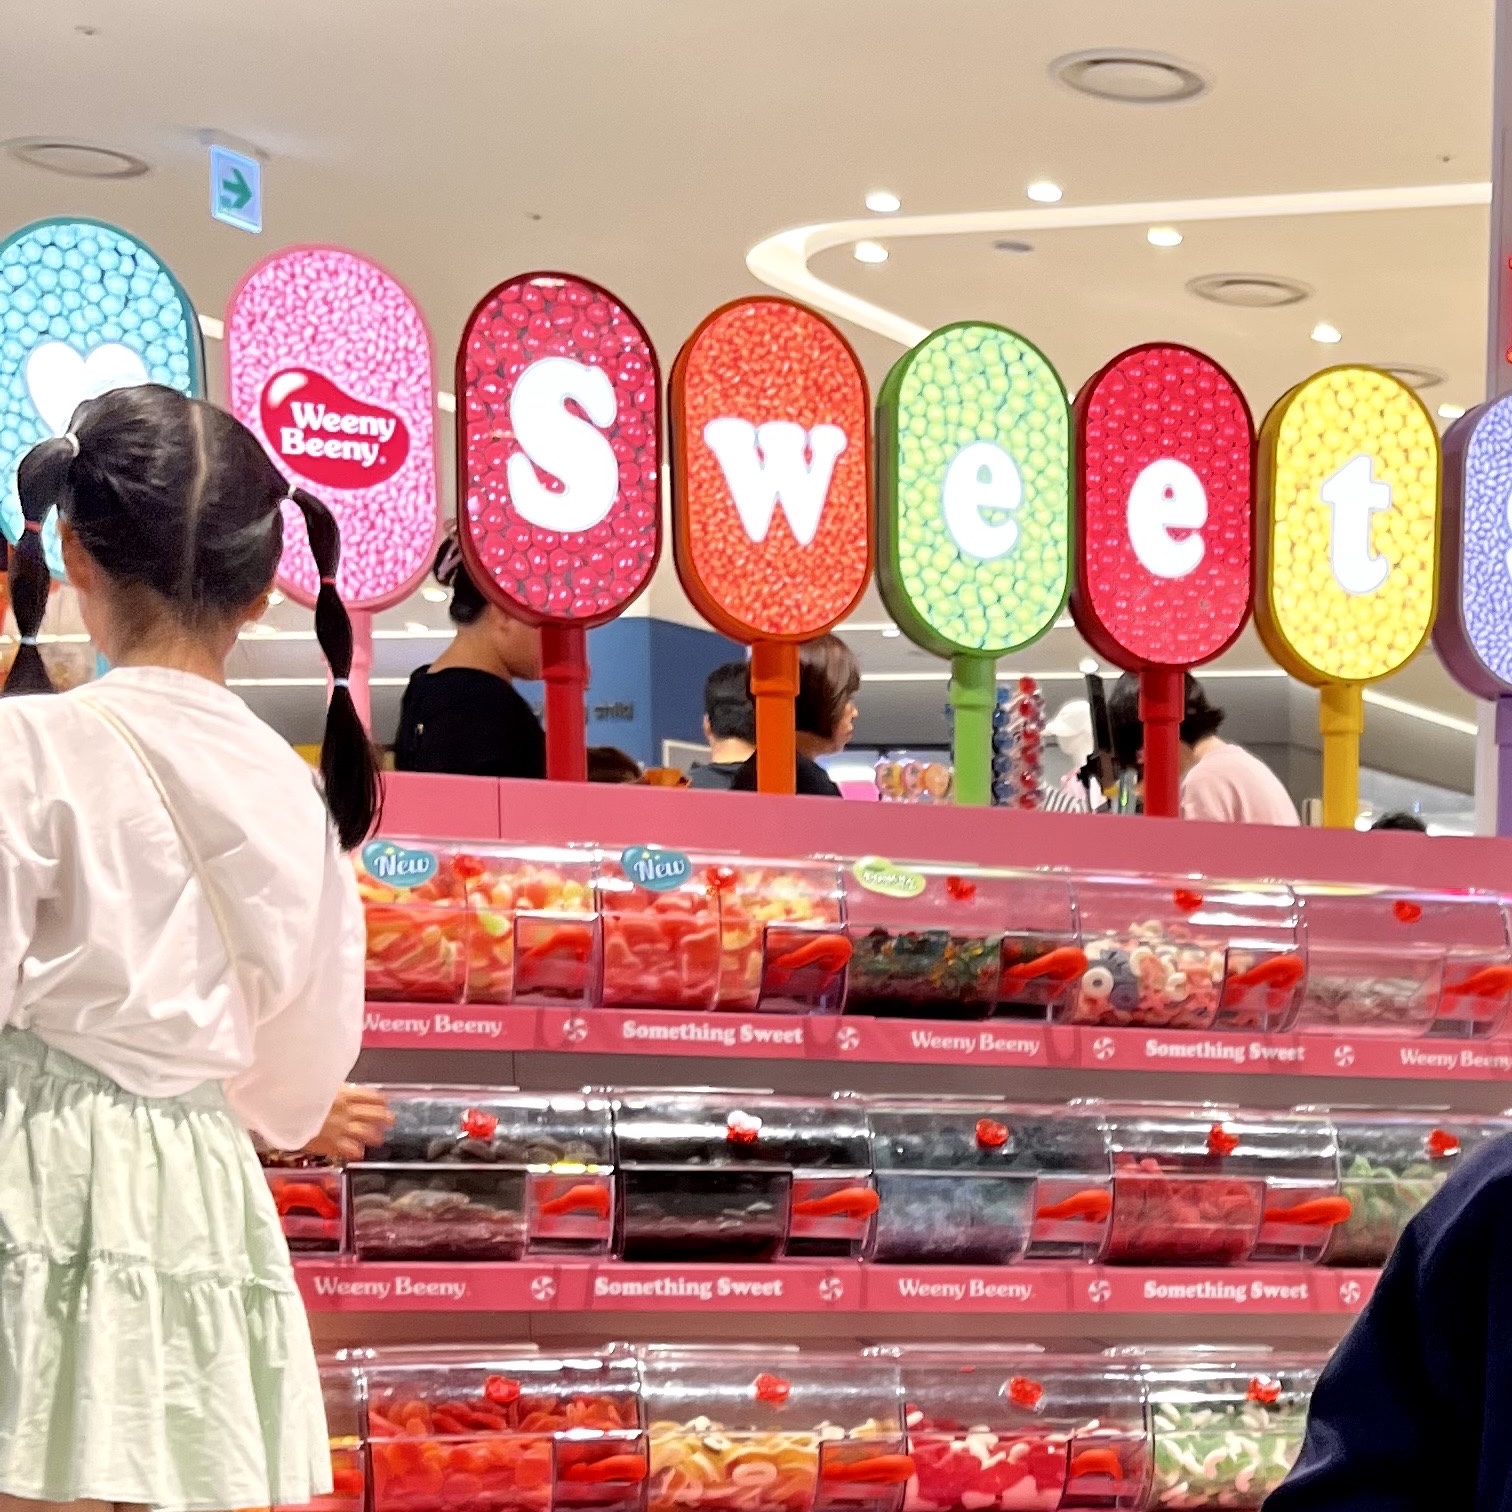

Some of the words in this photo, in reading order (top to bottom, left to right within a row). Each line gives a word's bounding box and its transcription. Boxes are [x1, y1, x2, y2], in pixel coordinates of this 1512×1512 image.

[289, 401, 396, 442] Weeny
[373, 851, 430, 878] New
[634, 856, 685, 882] New
[362, 1013, 431, 1036] Weeny
[434, 1013, 502, 1038] Beeny
[623, 1020, 737, 1045] Something
[740, 1024, 803, 1045] Sweet
[911, 1030, 977, 1054] Weeny
[979, 1032, 1040, 1057] Beeny
[1145, 1039, 1245, 1063] Something
[1248, 1041, 1306, 1063] Sweet
[1400, 1048, 1458, 1071] Weeny
[313, 1275, 392, 1299] Weeny
[394, 1276, 467, 1299] Beeny
[594, 1276, 713, 1301] Something
[716, 1277, 783, 1297] Sweet
[898, 1278, 966, 1300] Weeny
[969, 1279, 1032, 1301] Beeny
[1143, 1280, 1247, 1303] Something
[1250, 1280, 1309, 1300] Sweet
